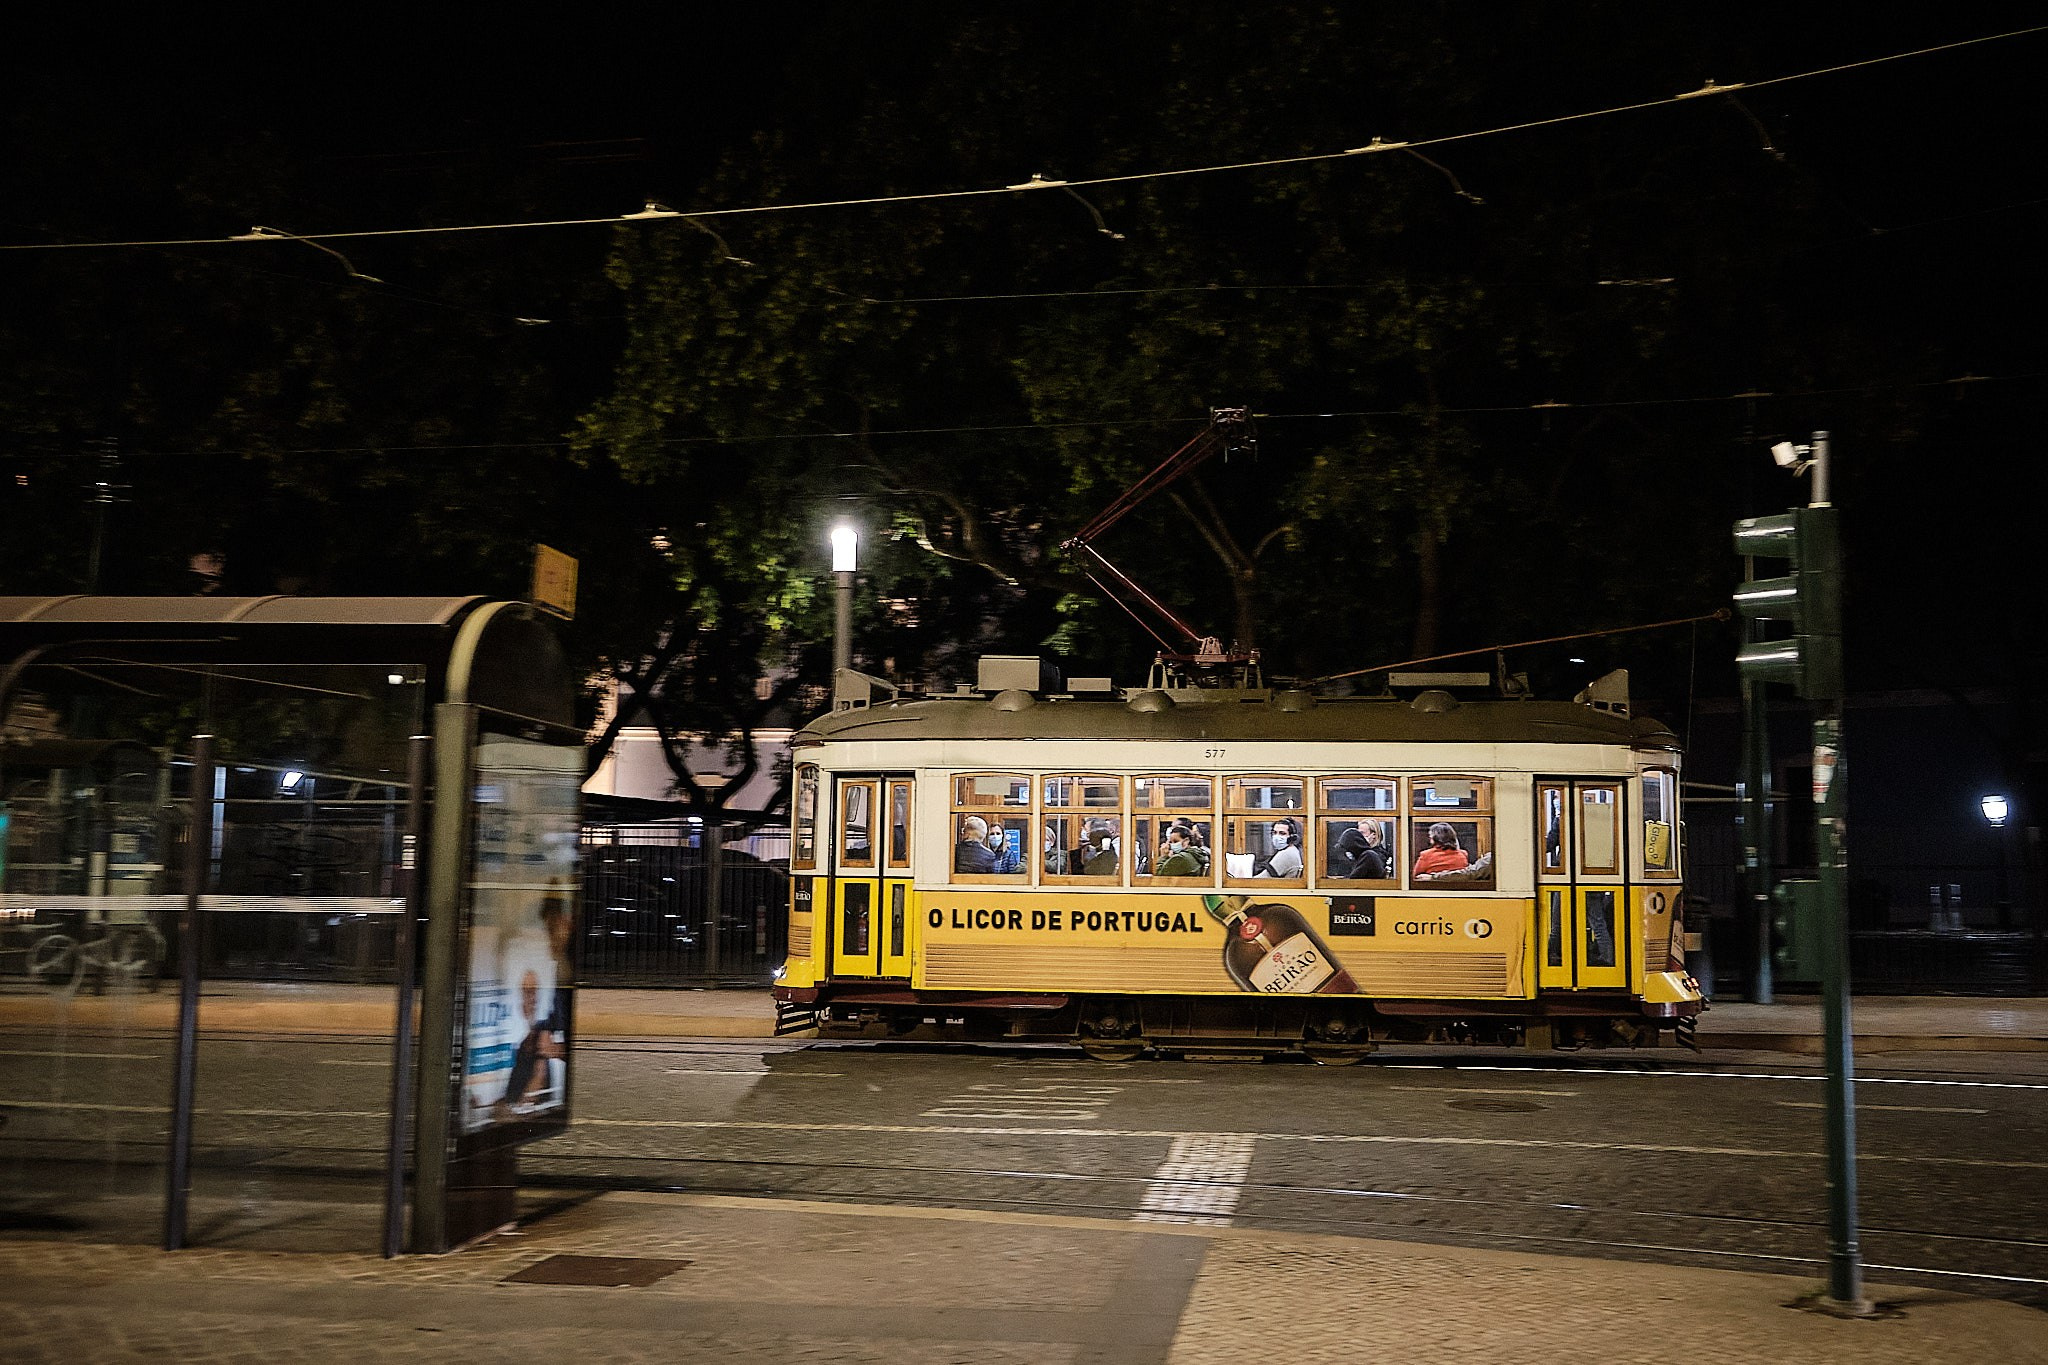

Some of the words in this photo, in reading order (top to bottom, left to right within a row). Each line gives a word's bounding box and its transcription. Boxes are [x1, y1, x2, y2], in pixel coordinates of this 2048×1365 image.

[1204, 749, 1226, 759] 577
[928, 908, 943, 929] O
[952, 909, 1023, 930] LICOR
[1031, 910, 1062, 930] DE
[1071, 911, 1203, 933] PORTUGAL
[1333, 914, 1372, 925] BEIRÃO
[1394, 917, 1454, 936] carris
